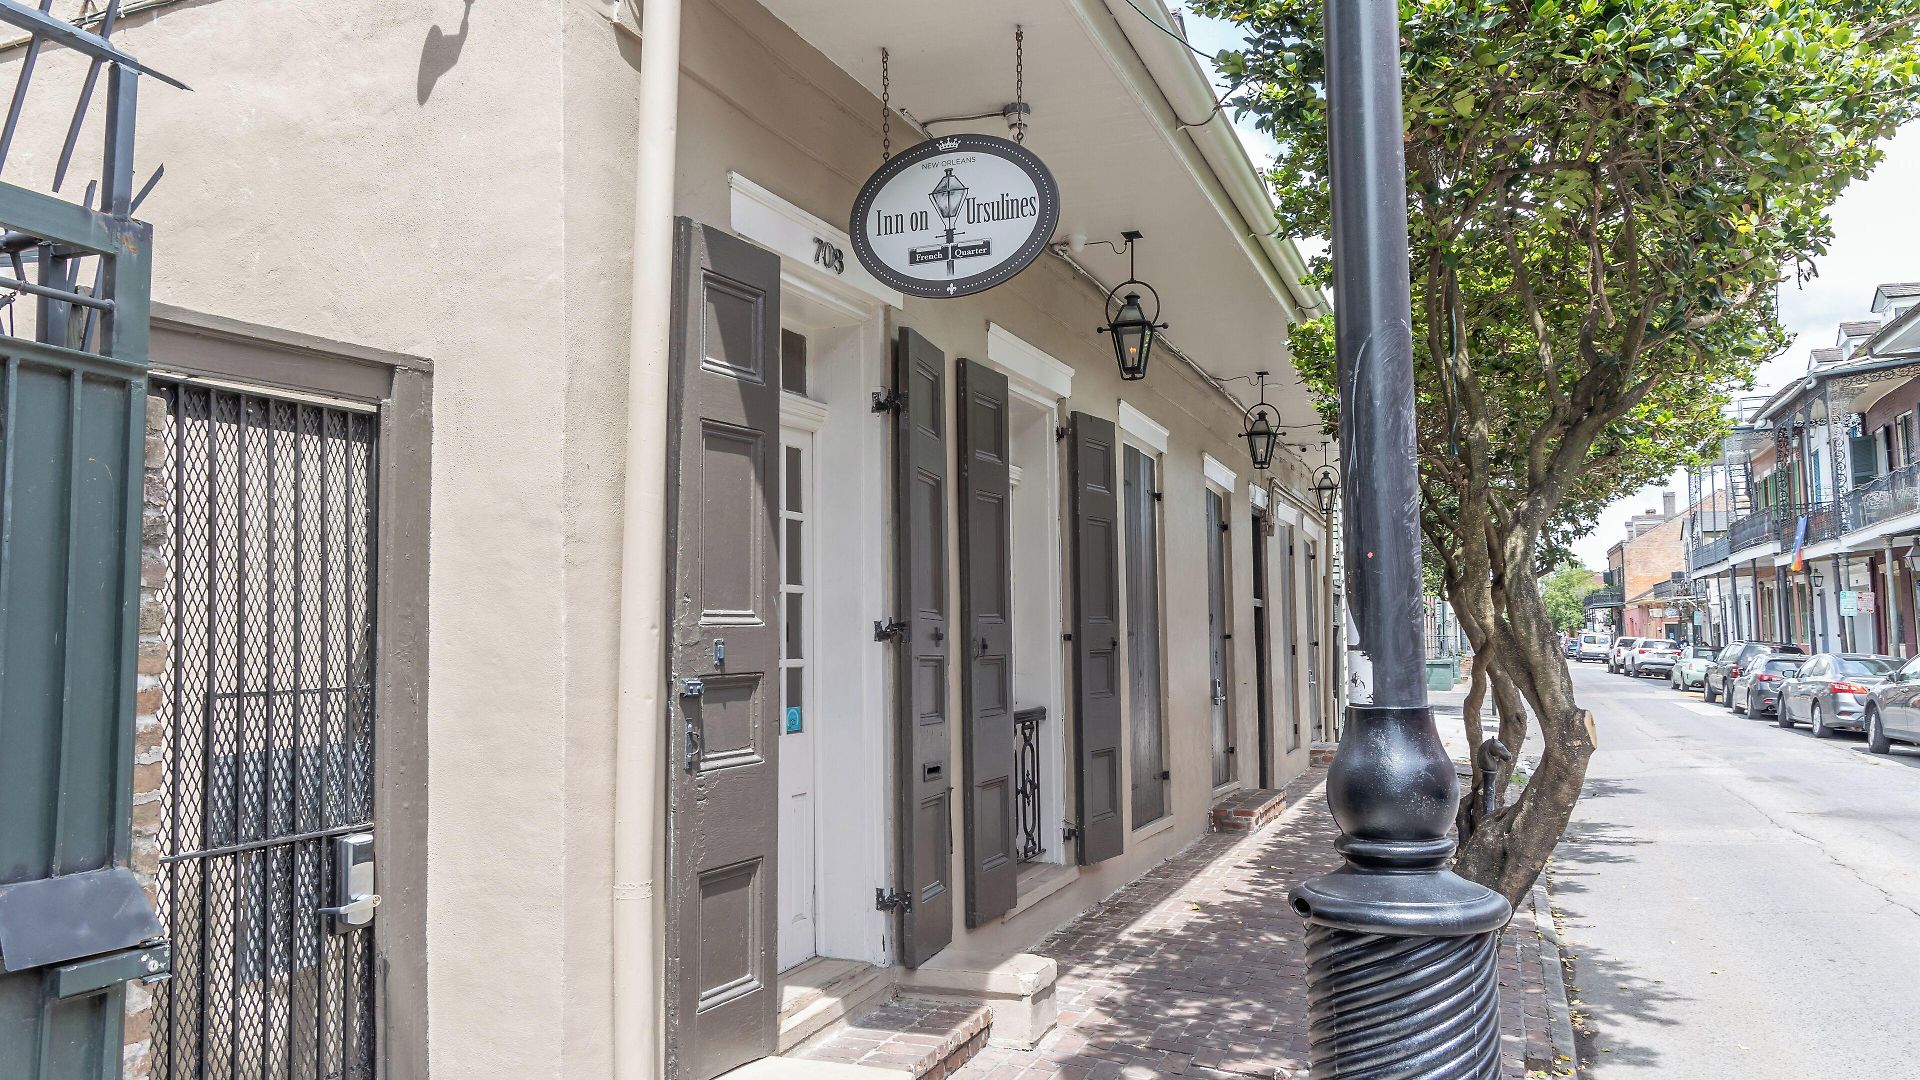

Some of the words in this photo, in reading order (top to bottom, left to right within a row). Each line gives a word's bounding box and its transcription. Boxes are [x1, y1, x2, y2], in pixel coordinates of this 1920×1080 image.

[921, 161, 940, 170] NEW
[941, 156, 976, 168] ORLEANS
[876, 210, 905, 237] Inn
[910, 209, 929, 232] on
[965, 193, 1037, 225] Ursulines
[915, 251, 943, 262] French
[954, 247, 988, 258] Quarter
